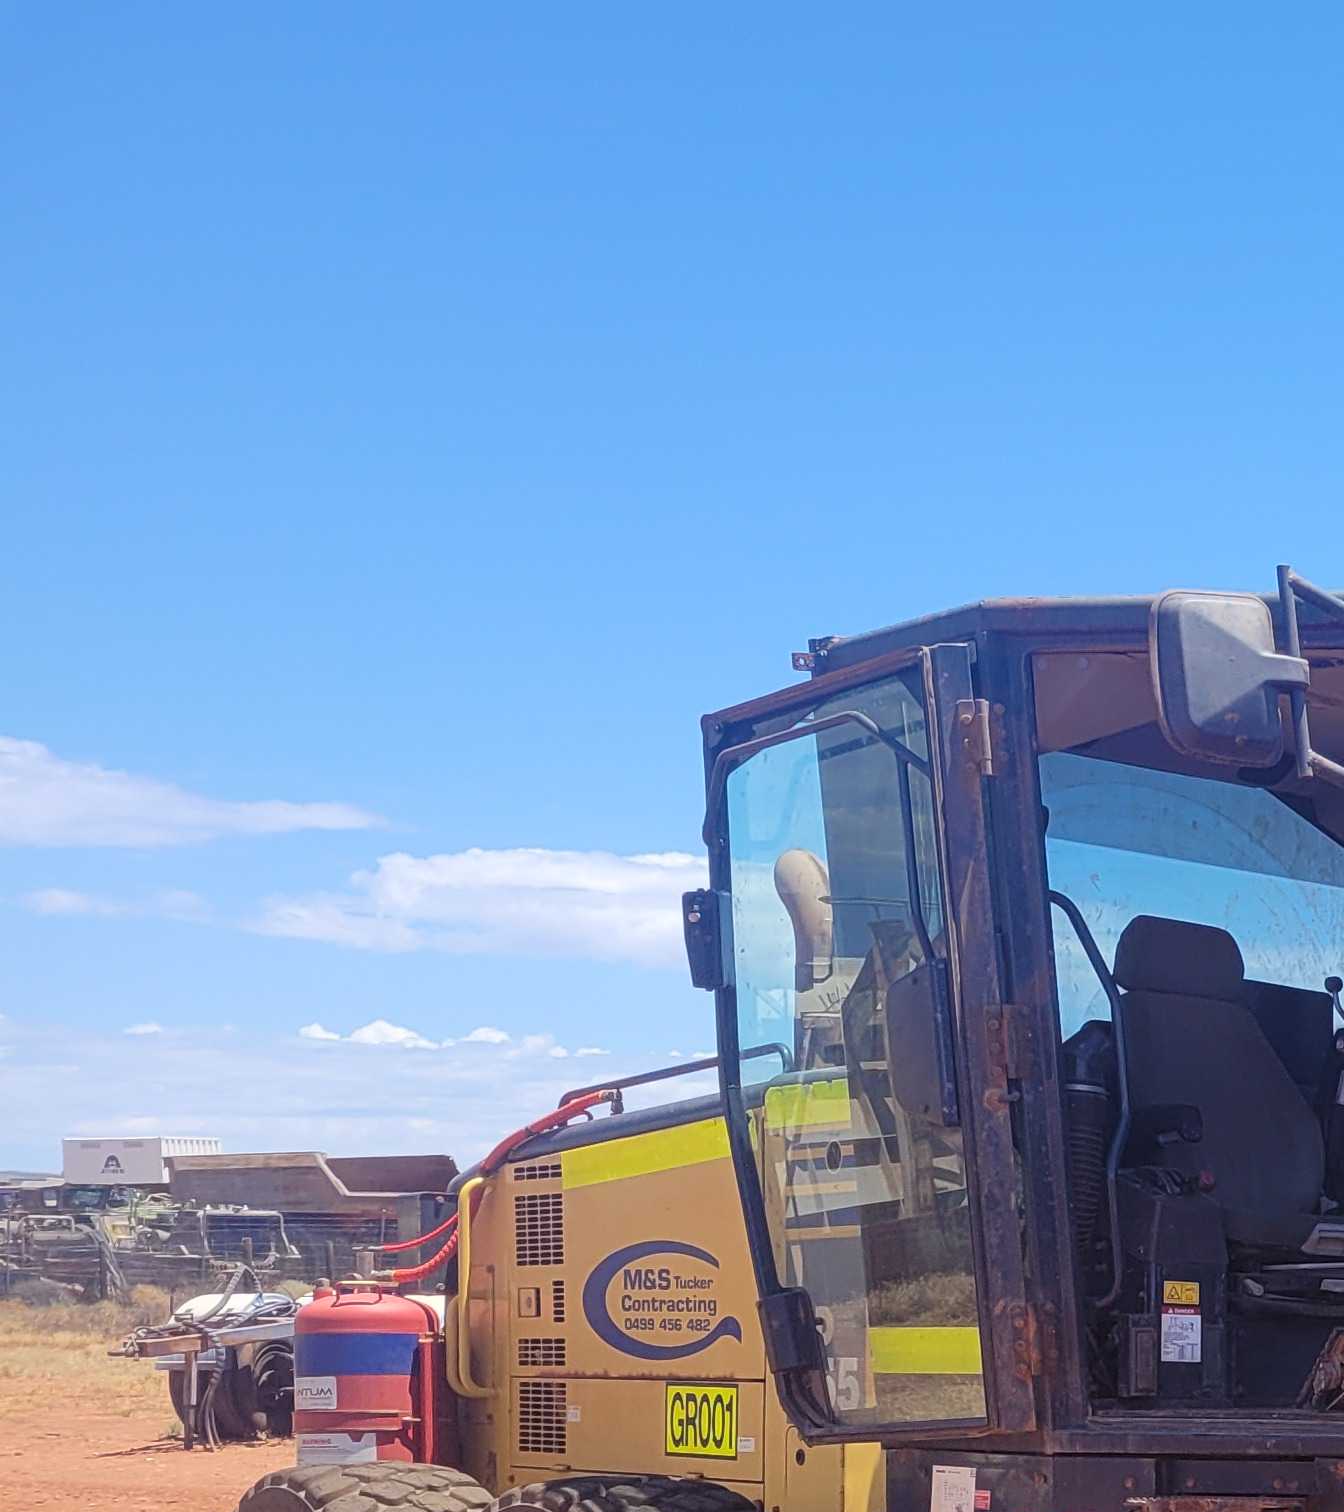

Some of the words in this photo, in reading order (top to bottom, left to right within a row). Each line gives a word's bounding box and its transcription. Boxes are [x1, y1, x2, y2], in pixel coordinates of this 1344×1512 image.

[624, 1269, 671, 1290] M&S
[674, 1276, 714, 1289] Tucker
[621, 1295, 717, 1316] Contracting
[624, 1318, 655, 1330] 0499
[659, 1318, 682, 1331] 456
[686, 1319, 711, 1331] 482
[670, 1391, 734, 1450] GR001
